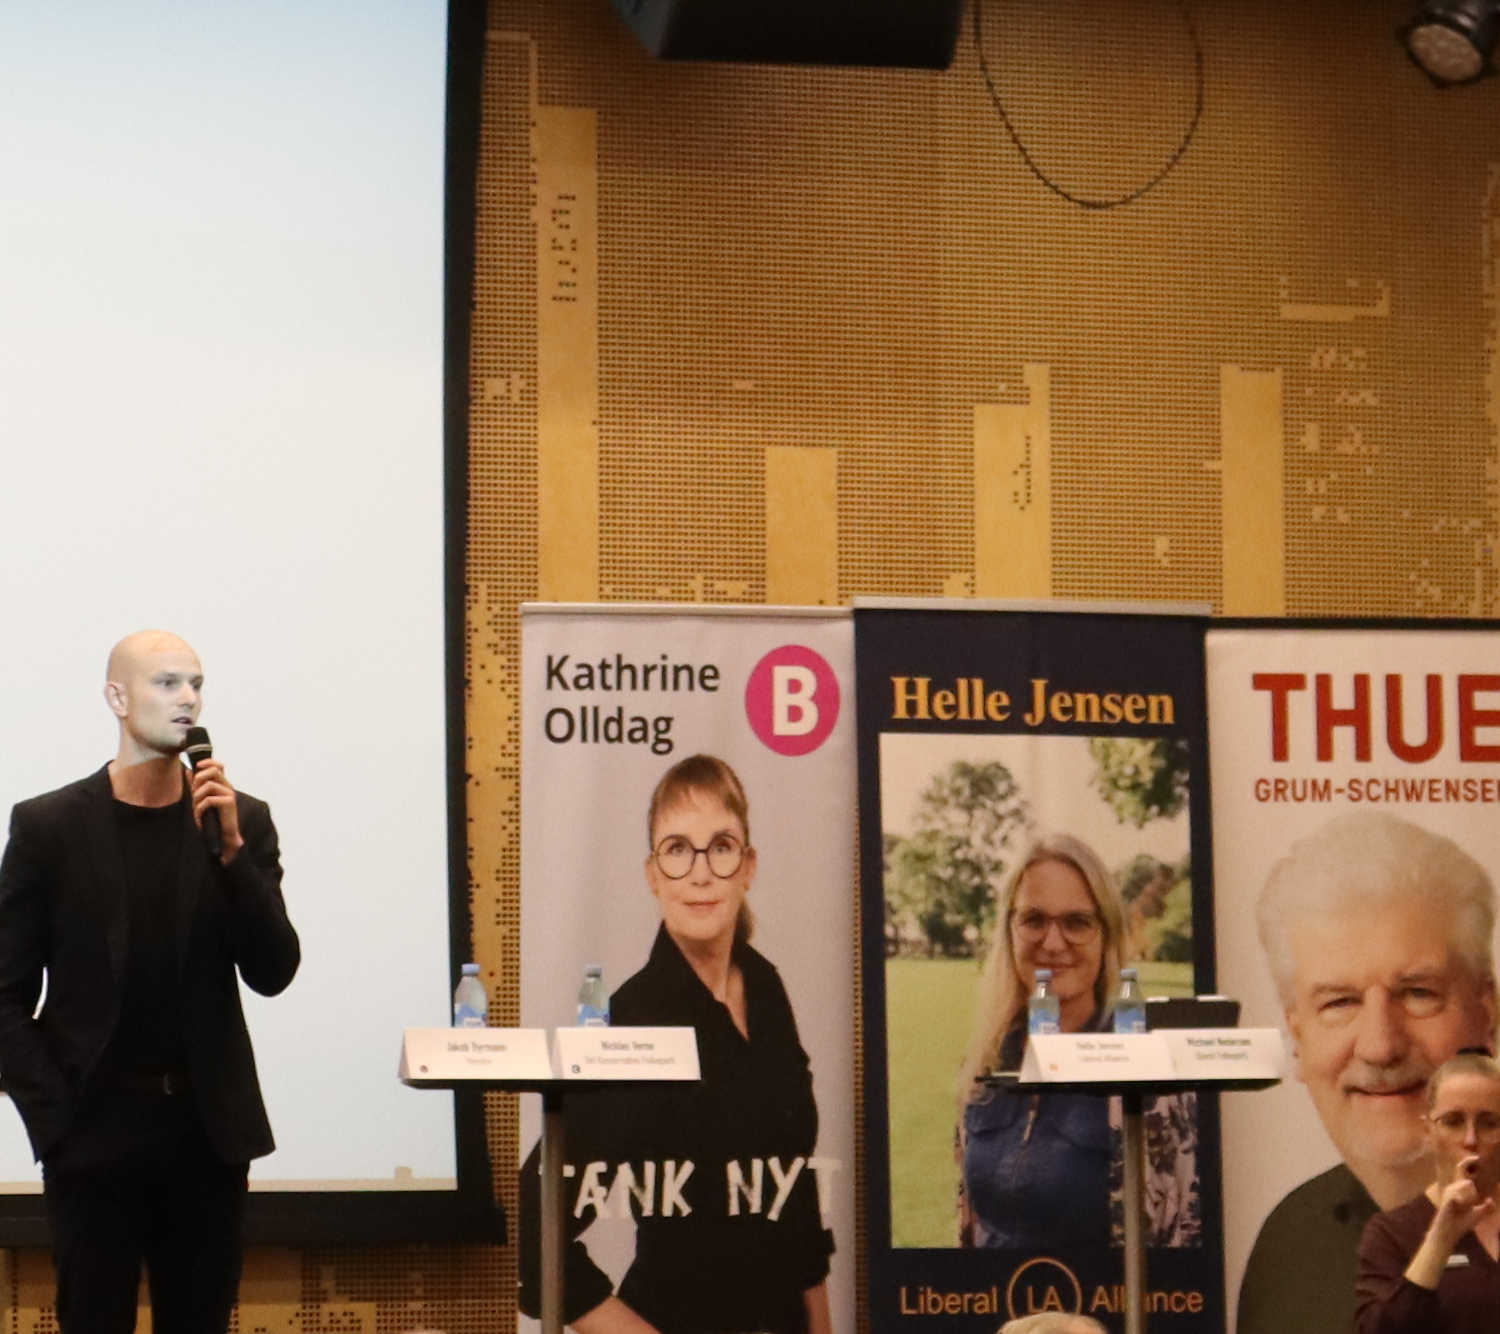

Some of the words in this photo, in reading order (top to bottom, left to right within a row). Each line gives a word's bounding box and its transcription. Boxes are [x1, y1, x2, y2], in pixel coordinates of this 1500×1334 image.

[546, 654, 720, 692] Kathrine
[772, 665, 819, 737] B
[890, 676, 1010, 722] Helle
[1024, 678, 1175, 726] Jensen
[544, 707, 674, 755] Olldag
[727, 1155, 843, 1222] NYT
[900, 1286, 998, 1315] Liberal
[1090, 1285, 1204, 1313] Allnce
